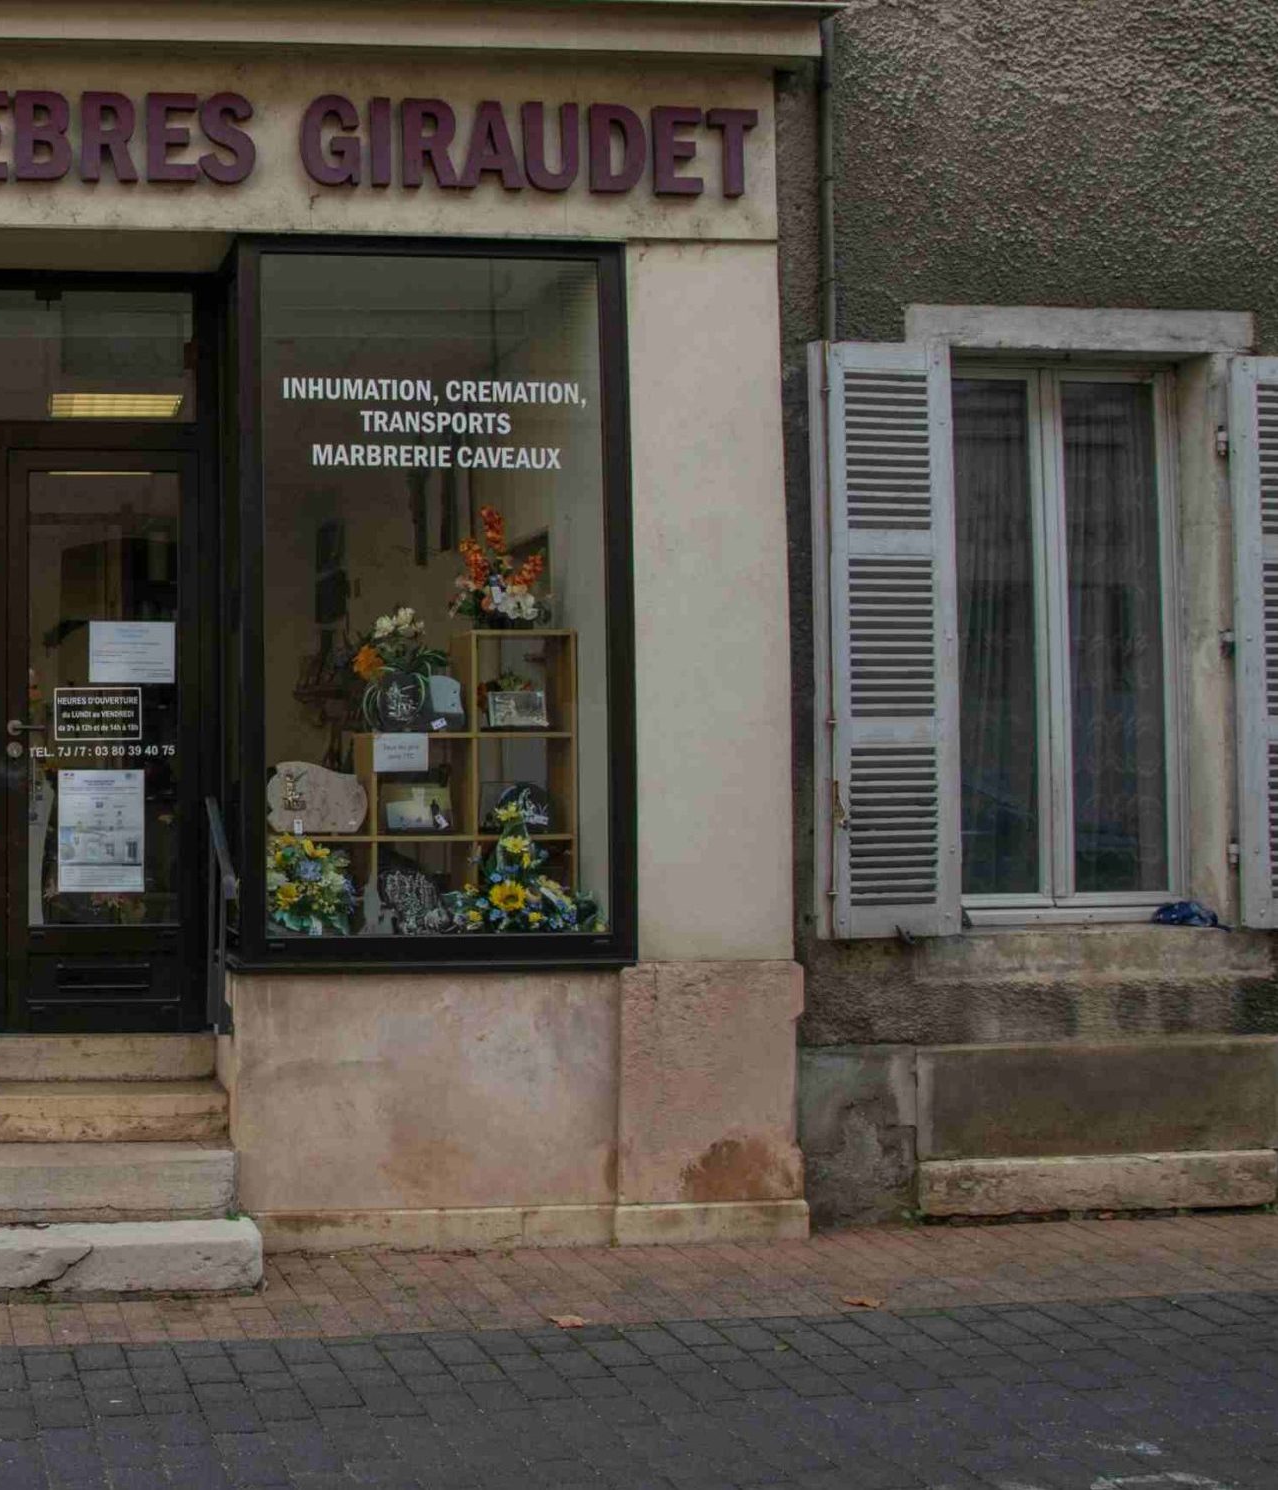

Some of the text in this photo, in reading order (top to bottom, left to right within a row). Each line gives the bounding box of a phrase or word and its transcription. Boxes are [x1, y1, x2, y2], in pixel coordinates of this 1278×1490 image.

[299, 93, 759, 198] GIRAUDET
[283, 377, 588, 408] INHUMATION, CREMATION,
[360, 411, 512, 435] TRANSPORTS
[312, 444, 563, 470] MARBRERIE CAVEAUX
[57, 695, 139, 705] HEURES D'OUVERTURE
[71, 710, 92, 719] LUNDI
[101, 710, 135, 719] VENDREDI
[29, 747, 55, 758] TEL.
[95, 746, 109, 757] 03
[111, 746, 125, 757] 80
[128, 745, 142, 757] 39
[144, 745, 159, 757] 40
[162, 745, 176, 756] 75
